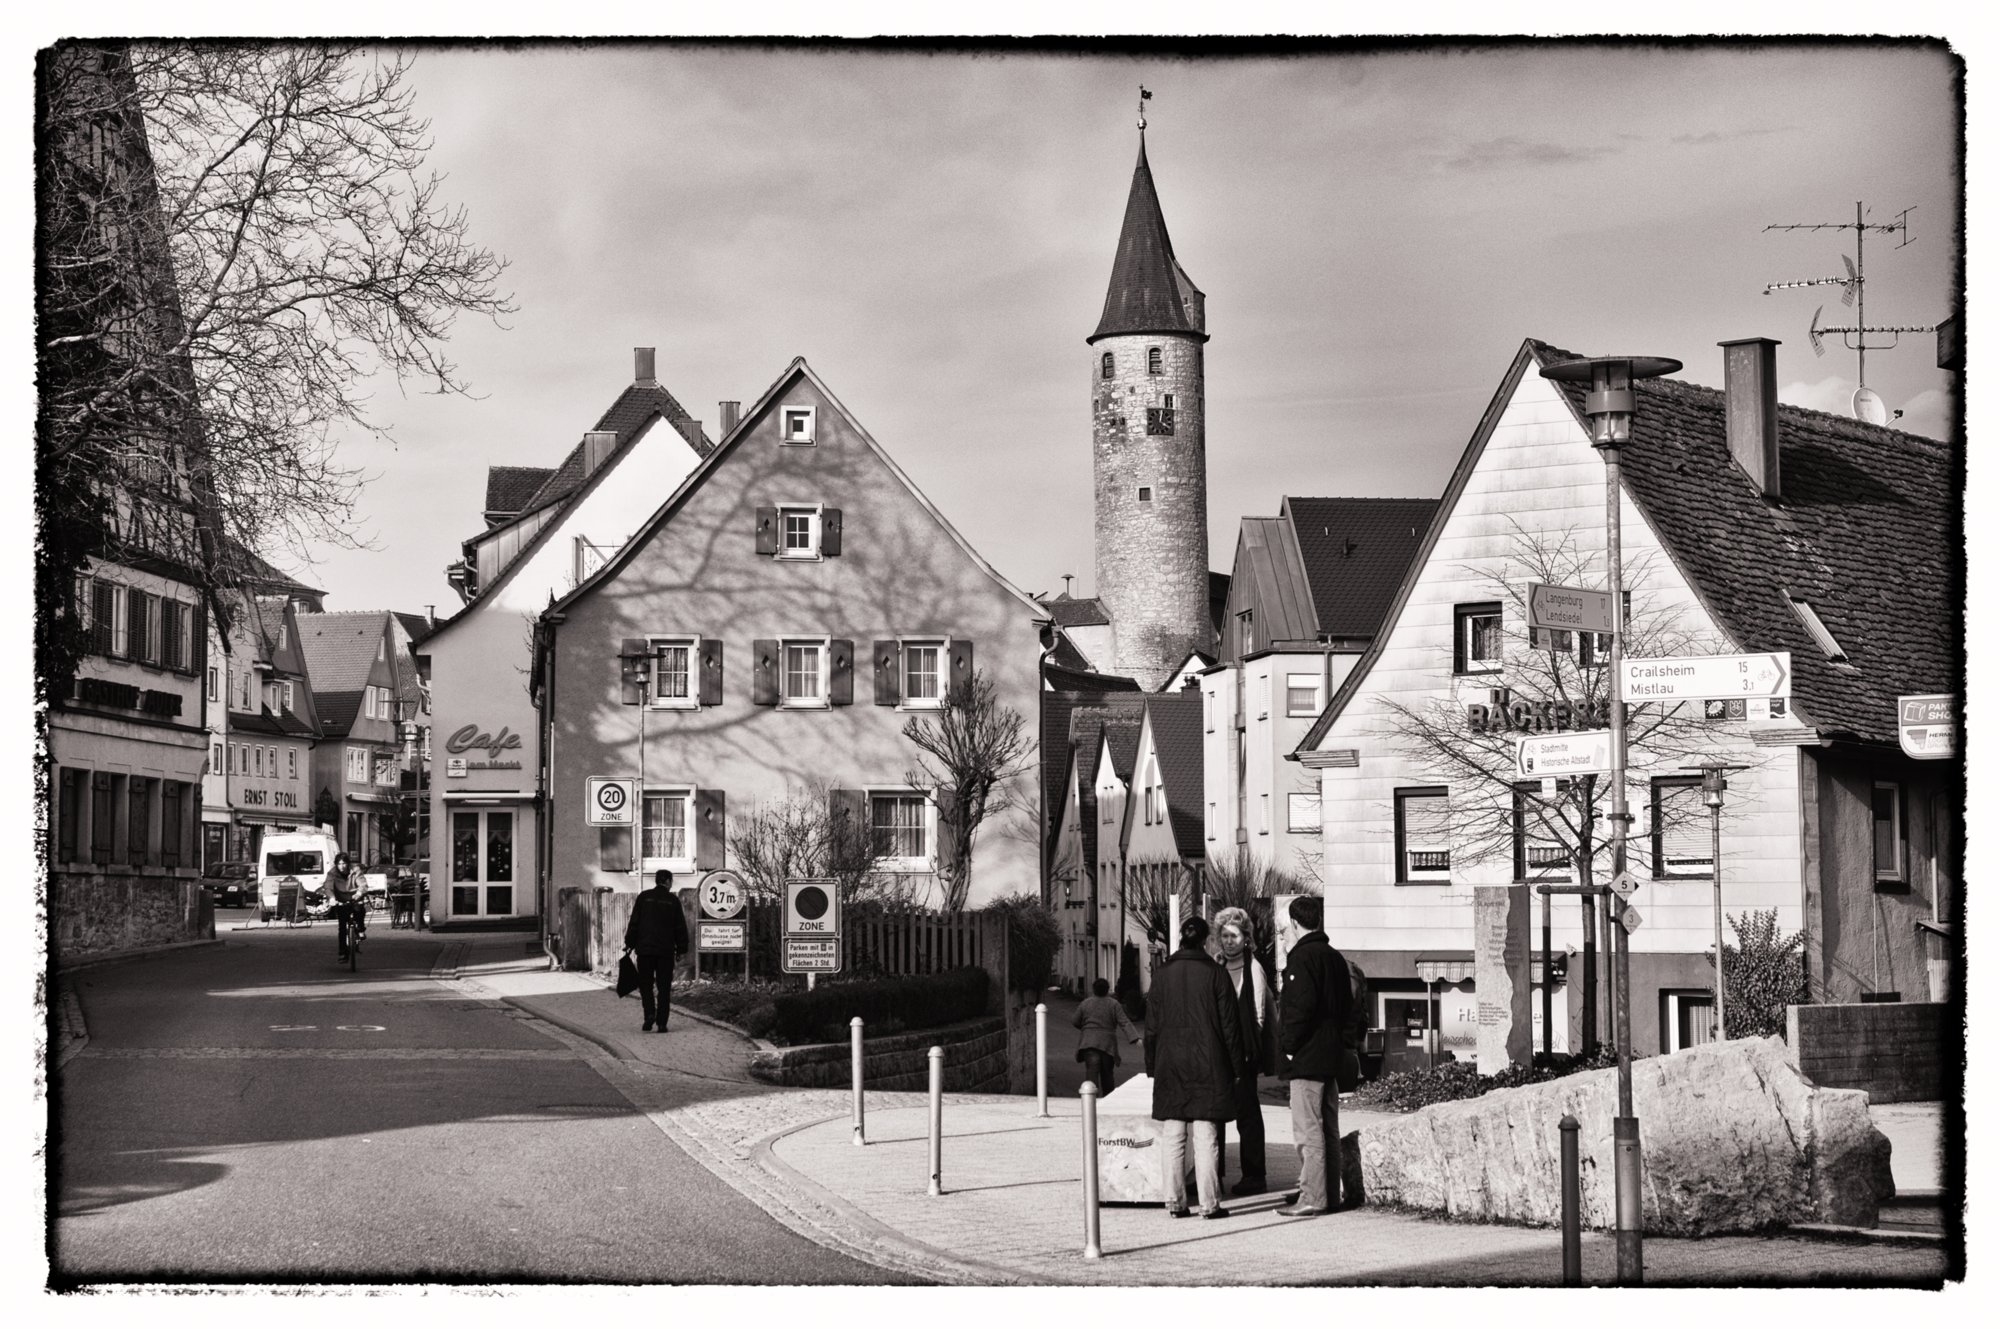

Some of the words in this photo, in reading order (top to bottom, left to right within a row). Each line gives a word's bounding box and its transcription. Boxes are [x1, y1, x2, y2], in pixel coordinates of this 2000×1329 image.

[1546, 591, 1583, 610] Langenburg
[1546, 608, 1583, 624] Lendsiedel
[1630, 665, 1695, 678] Crailsheim
[1738, 661, 1748, 673] 15
[1631, 683, 1674, 695] Mistlau
[446, 723, 521, 759] Cafe
[1540, 743, 1569, 753] Stadtmitte
[1540, 757, 1570, 767] Historische
[1570, 754, 1591, 765] Altstadt
[244, 788, 268, 806] ERNST
[274, 791, 298, 808] STOLL
[603, 790, 620, 804] 20
[600, 813, 622, 821] ZONE
[1621, 880, 1628, 890] 5
[799, 921, 825, 931] ZONE
[789, 952, 835, 960] gekennzeichneten
[1098, 1137, 1136, 1147] ForstBW
